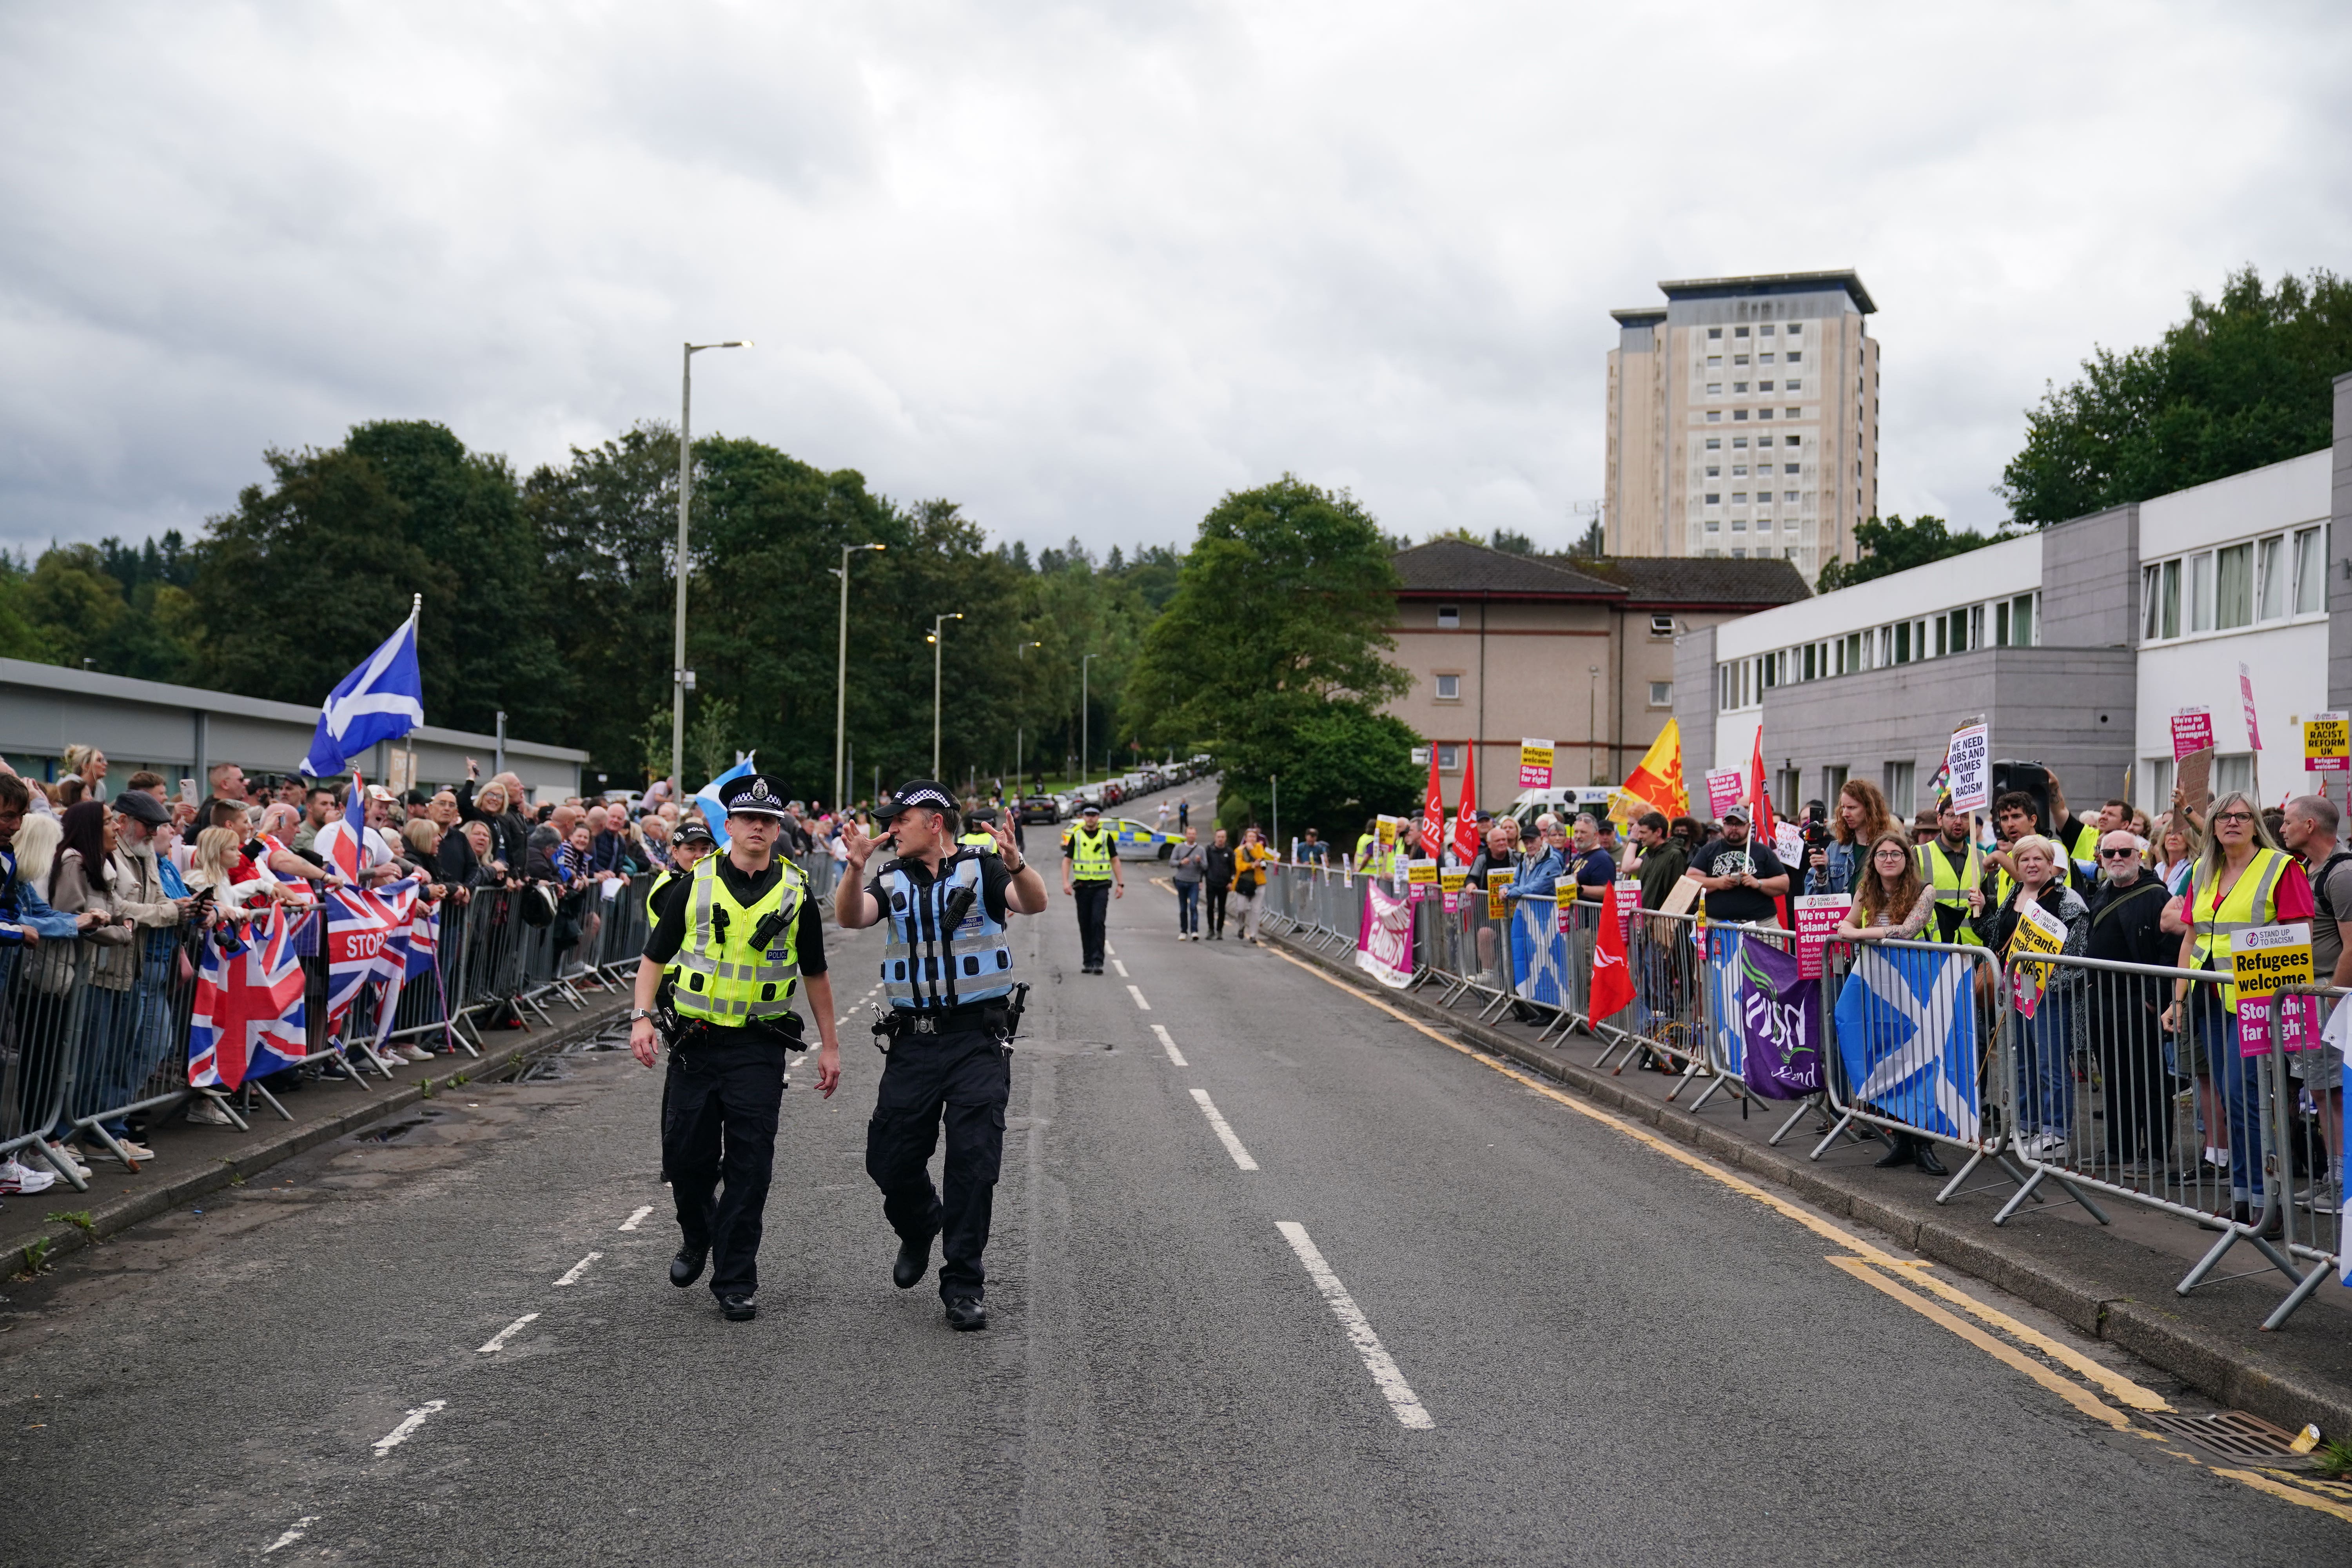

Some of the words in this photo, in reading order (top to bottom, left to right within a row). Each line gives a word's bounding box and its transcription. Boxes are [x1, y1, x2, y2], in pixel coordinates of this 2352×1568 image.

[2310, 730, 2343, 739] RACIST
[1952, 741, 1960, 753] WE
[1963, 736, 1983, 750] NEED
[2308, 739, 2345, 747] REFORM
[1524, 748, 1552, 757] Refugees
[1950, 751, 1966, 765] JOBS
[1969, 747, 1985, 759] AND
[1522, 766, 1537, 776] Stop
[1954, 759, 1980, 775] HOMES
[1521, 774, 1531, 782] far
[1532, 775, 1548, 785] right
[1961, 772, 1975, 784] NOT
[1956, 782, 1982, 797] RACISM
[1786, 843, 1797, 853] OUR
[1632, 899, 1637, 907] of
[1798, 910, 1825, 921] We're
[1828, 911, 1840, 919] no
[2040, 913, 2051, 924] STAND
[2042, 922, 2058, 935] RACISM
[2018, 918, 2058, 955] Migrants
[2270, 936, 2294, 944] RACISM
[347, 932, 384, 958] STOP
[2236, 953, 2308, 972] Refugees
[2238, 974, 2306, 992] welcome
[2242, 1024, 2263, 1042] far
